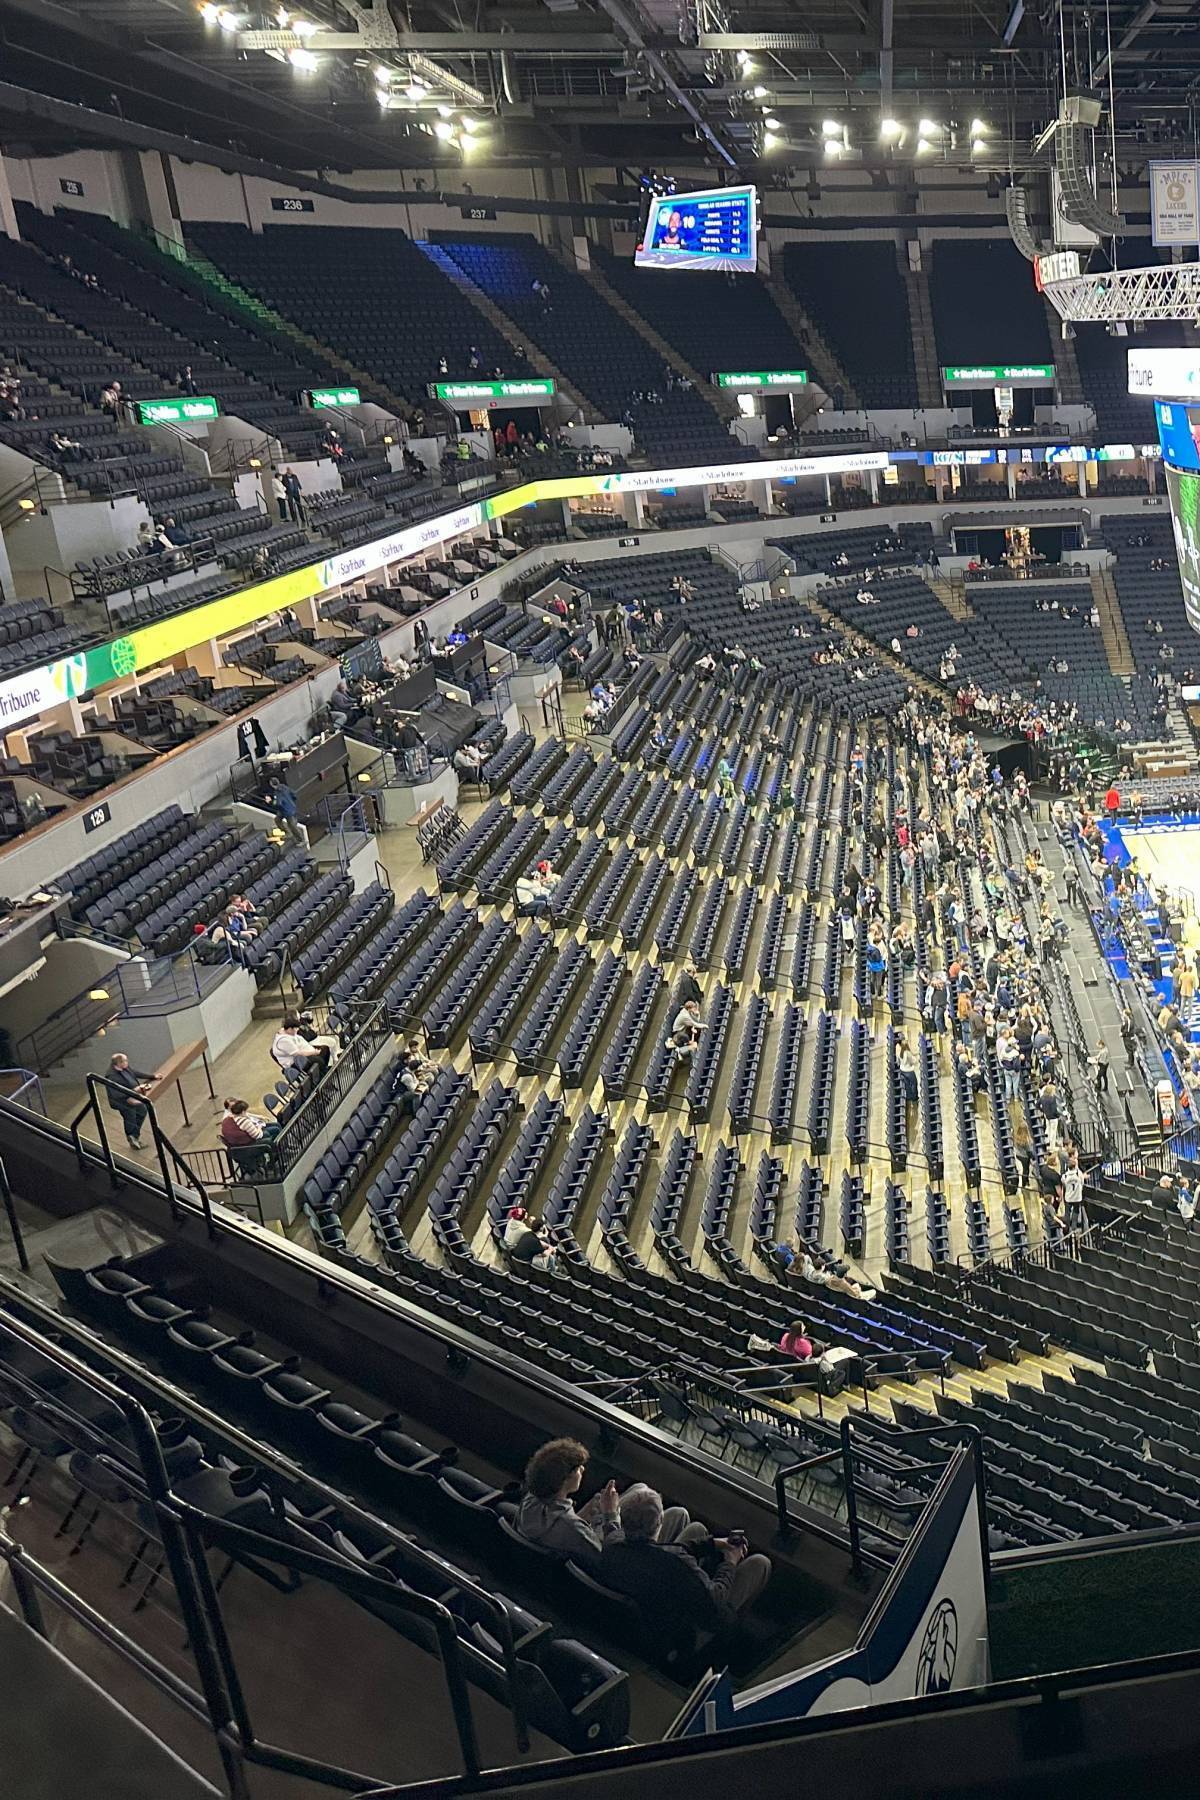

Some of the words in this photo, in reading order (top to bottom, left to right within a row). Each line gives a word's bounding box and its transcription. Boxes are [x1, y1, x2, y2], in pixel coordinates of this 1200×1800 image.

[1161, 171, 1189, 185] MPLS
[470, 209, 486, 219] 237
[90, 808, 105, 827] 129
